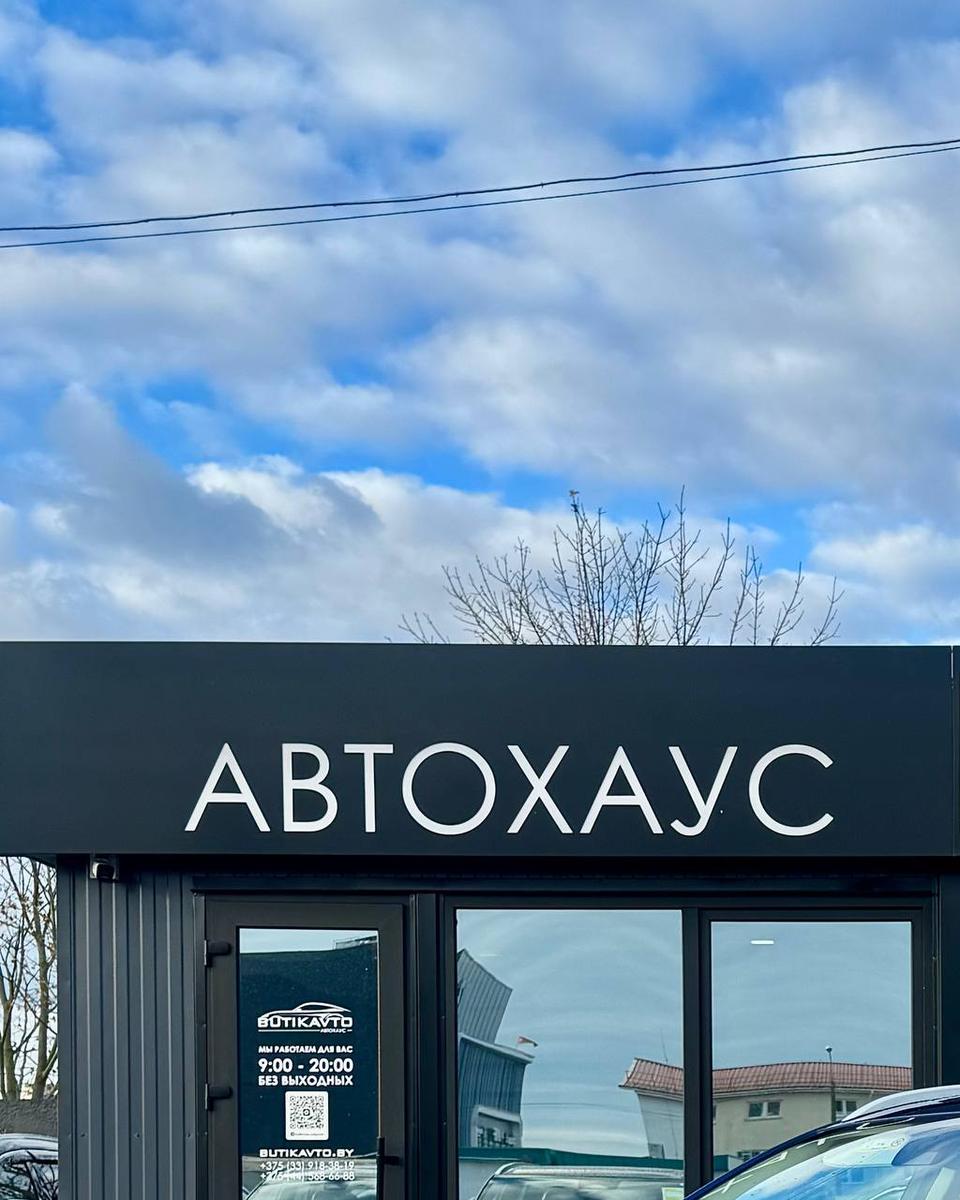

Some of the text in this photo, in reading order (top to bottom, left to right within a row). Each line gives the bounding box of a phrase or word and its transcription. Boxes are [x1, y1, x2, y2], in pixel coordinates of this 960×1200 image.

[184, 742, 834, 837] АВТОХАУС
[257, 1016, 353, 1028] BUTIKAVTO
[258, 1045, 354, 1054] МЫ РАБОТАЕМ ДЛЯ ВАС
[258, 1058, 293, 1073] 9:00
[309, 1058, 354, 1073] 20:00
[258, 1075, 354, 1087] БЕЗ ВЫХОДНЫХ
[259, 1148, 355, 1158] BUTIKAVTO.BY
[260, 1161, 355, 1172] +375 (33) 918-38-19
[307, 1171, 356, 1181] 568-66-88
